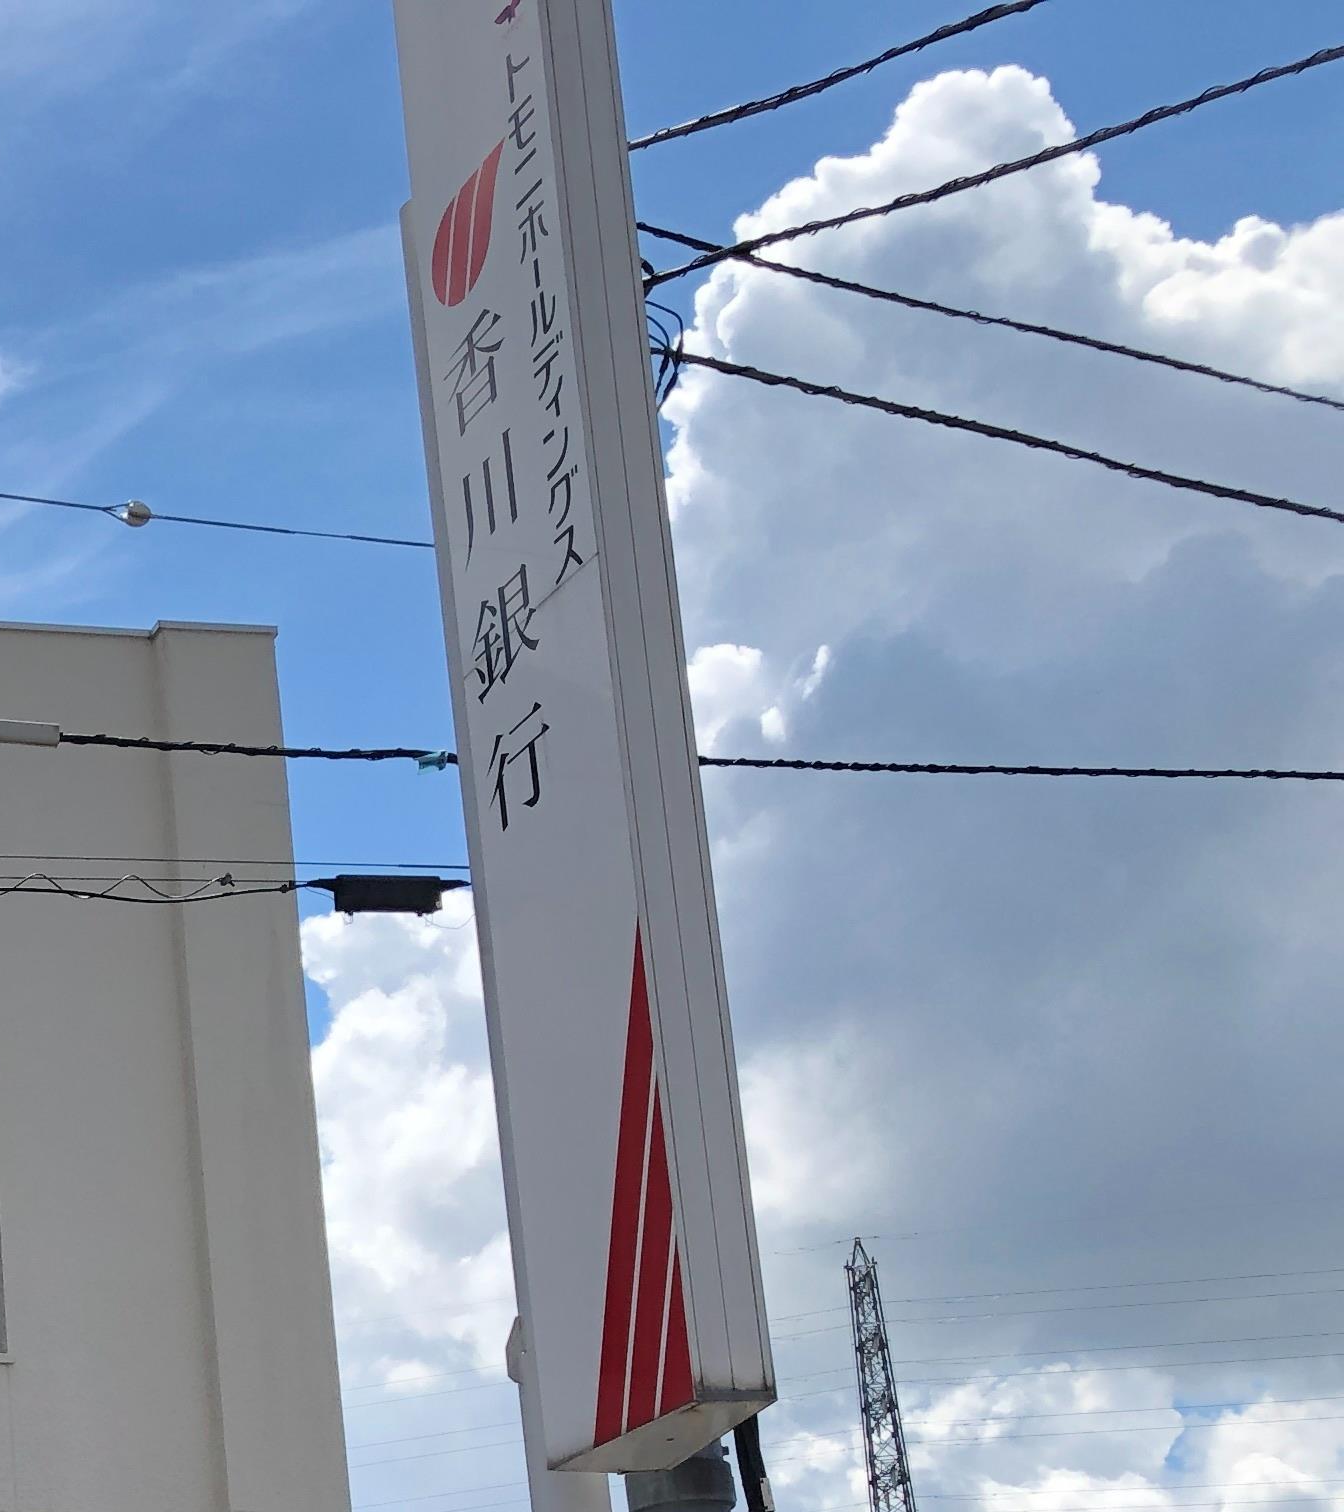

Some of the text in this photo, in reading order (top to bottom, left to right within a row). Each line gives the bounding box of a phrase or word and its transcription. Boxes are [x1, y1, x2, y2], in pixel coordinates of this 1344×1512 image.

[440, 307, 550, 832] 香川銀行
[505, 53, 584, 585] トモニホールディングス
